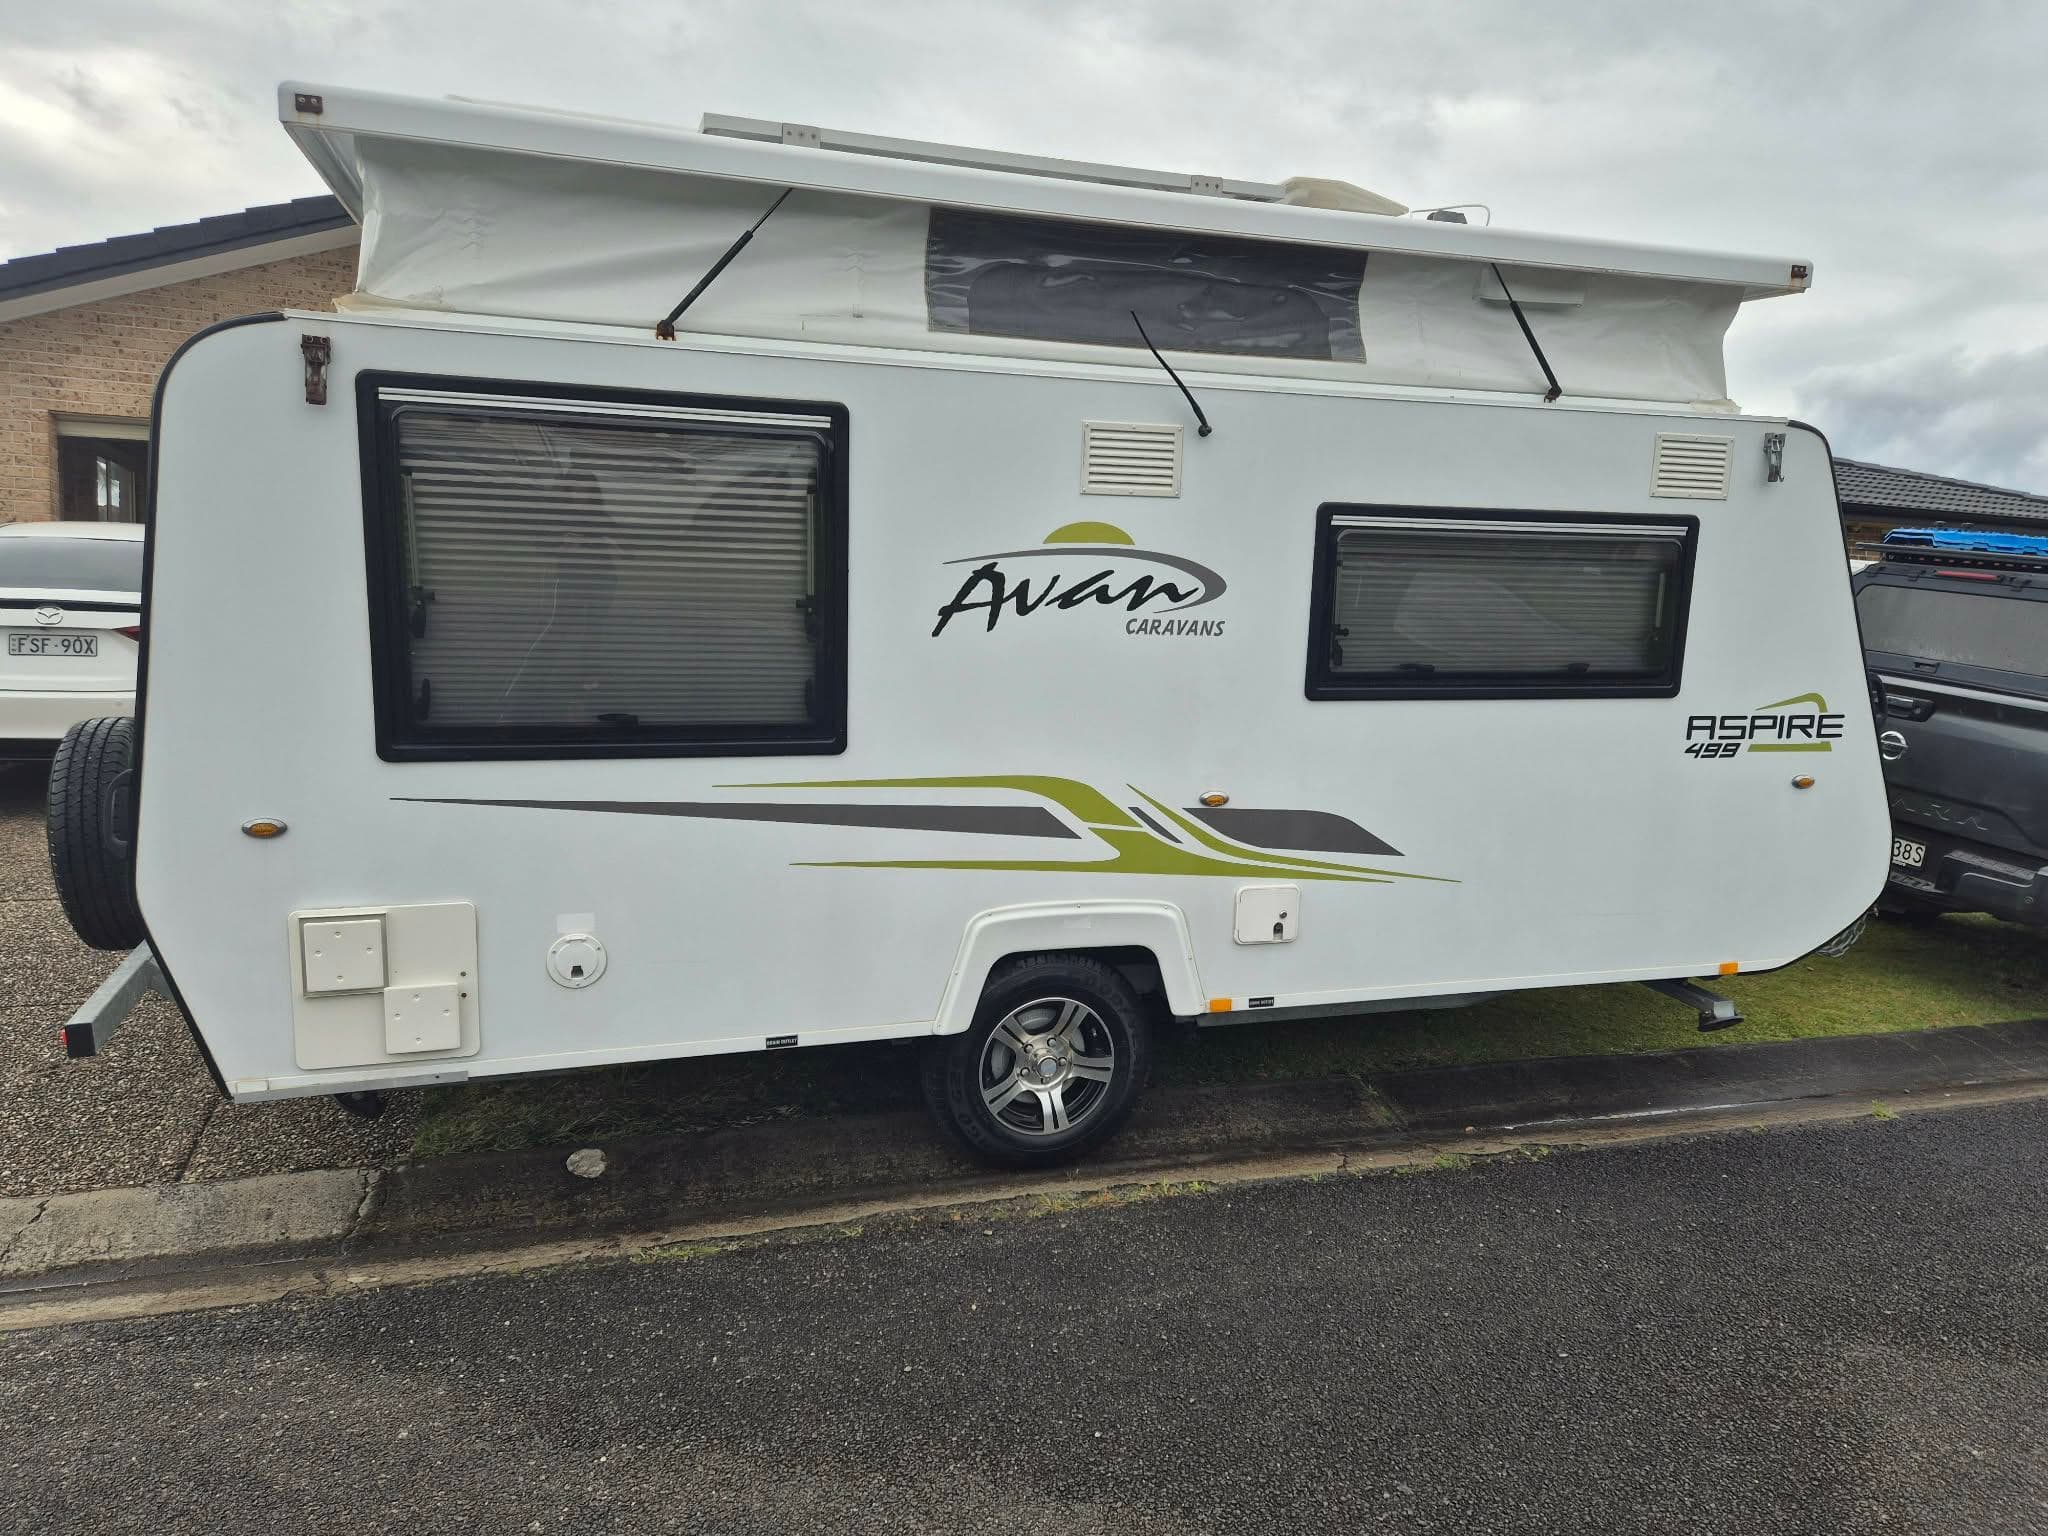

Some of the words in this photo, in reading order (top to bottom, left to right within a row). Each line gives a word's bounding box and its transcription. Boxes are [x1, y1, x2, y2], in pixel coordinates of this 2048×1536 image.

[931, 561, 1199, 637] Avan
[1125, 618, 1226, 637] CARAVANS
[1686, 714, 1845, 740] ASPIRE
[1684, 742, 1742, 759] 499
